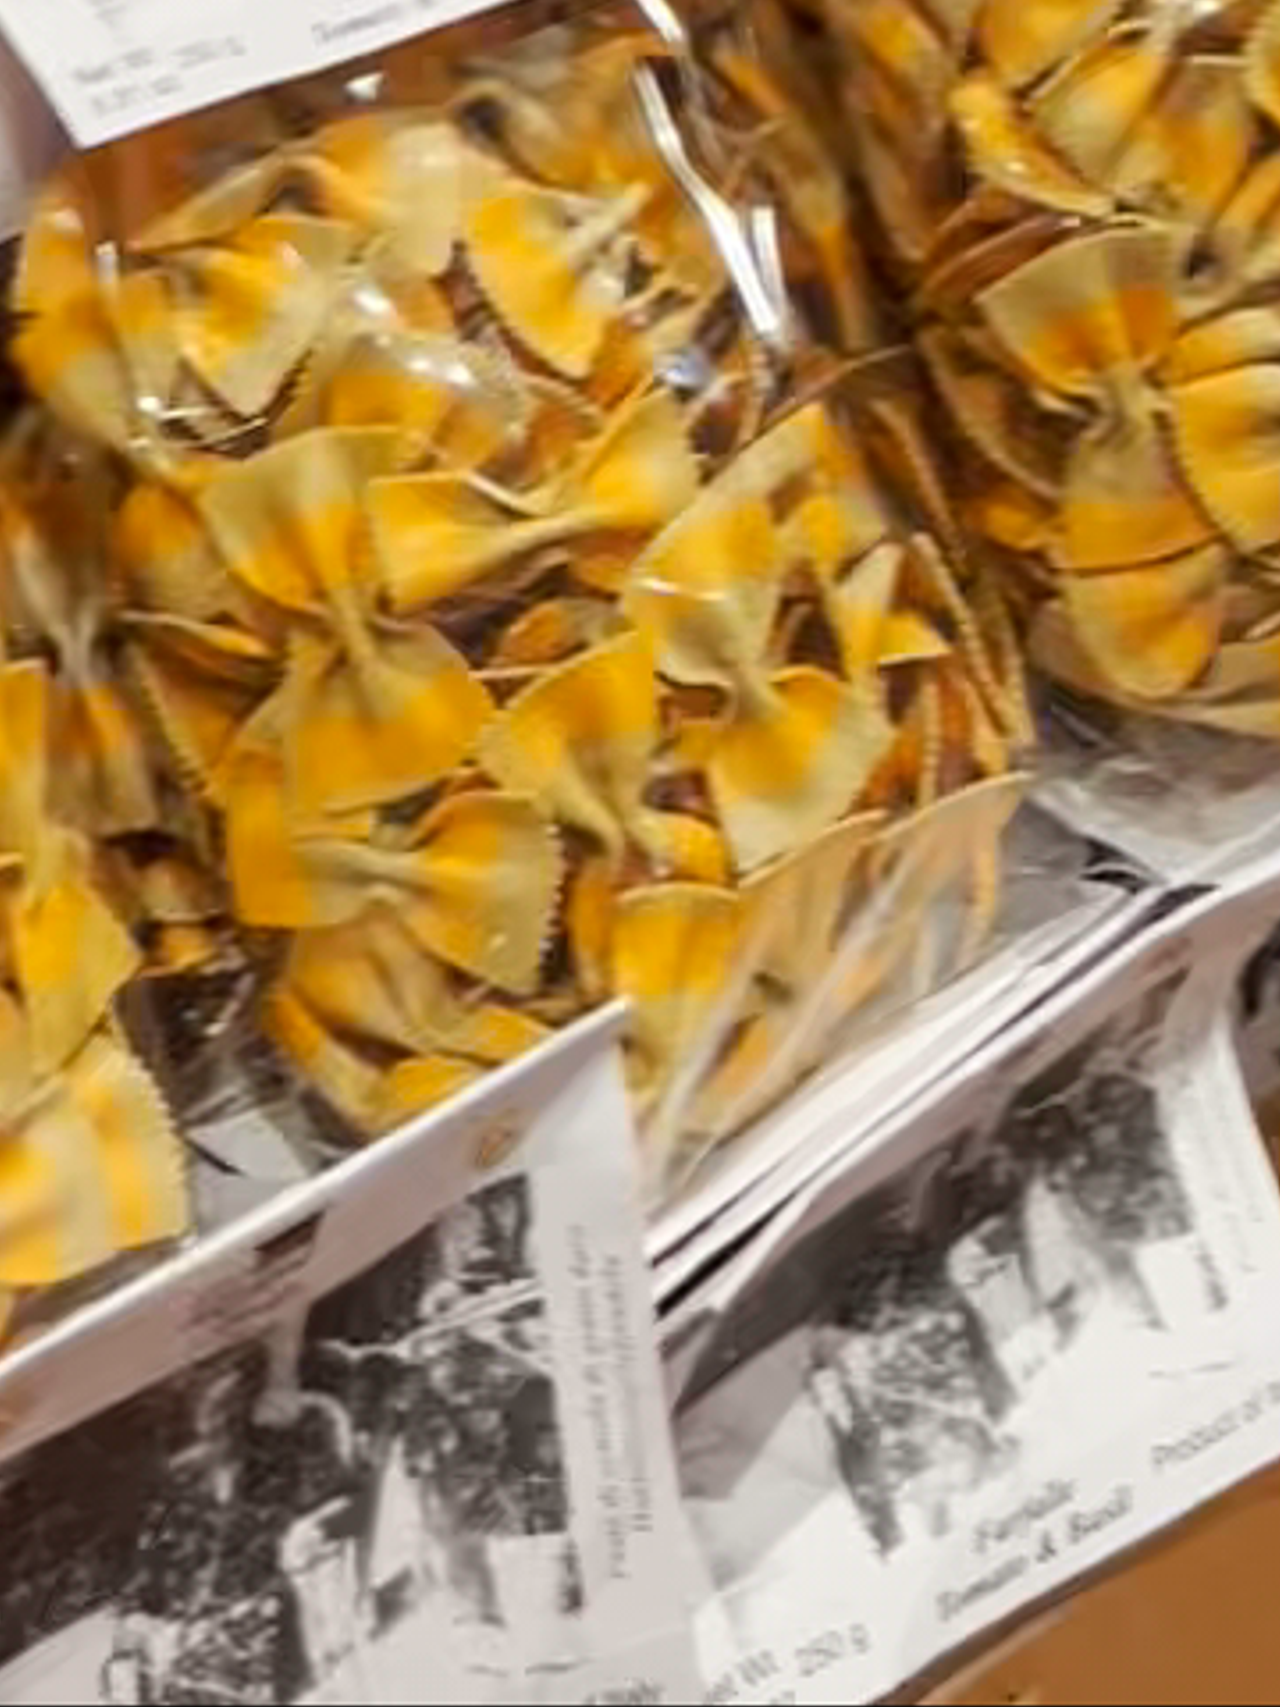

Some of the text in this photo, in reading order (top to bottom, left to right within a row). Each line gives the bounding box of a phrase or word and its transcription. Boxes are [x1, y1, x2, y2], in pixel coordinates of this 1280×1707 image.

[937, 1483, 1134, 1622] Tomato & Basil
[794, 1630, 844, 1678] 250
